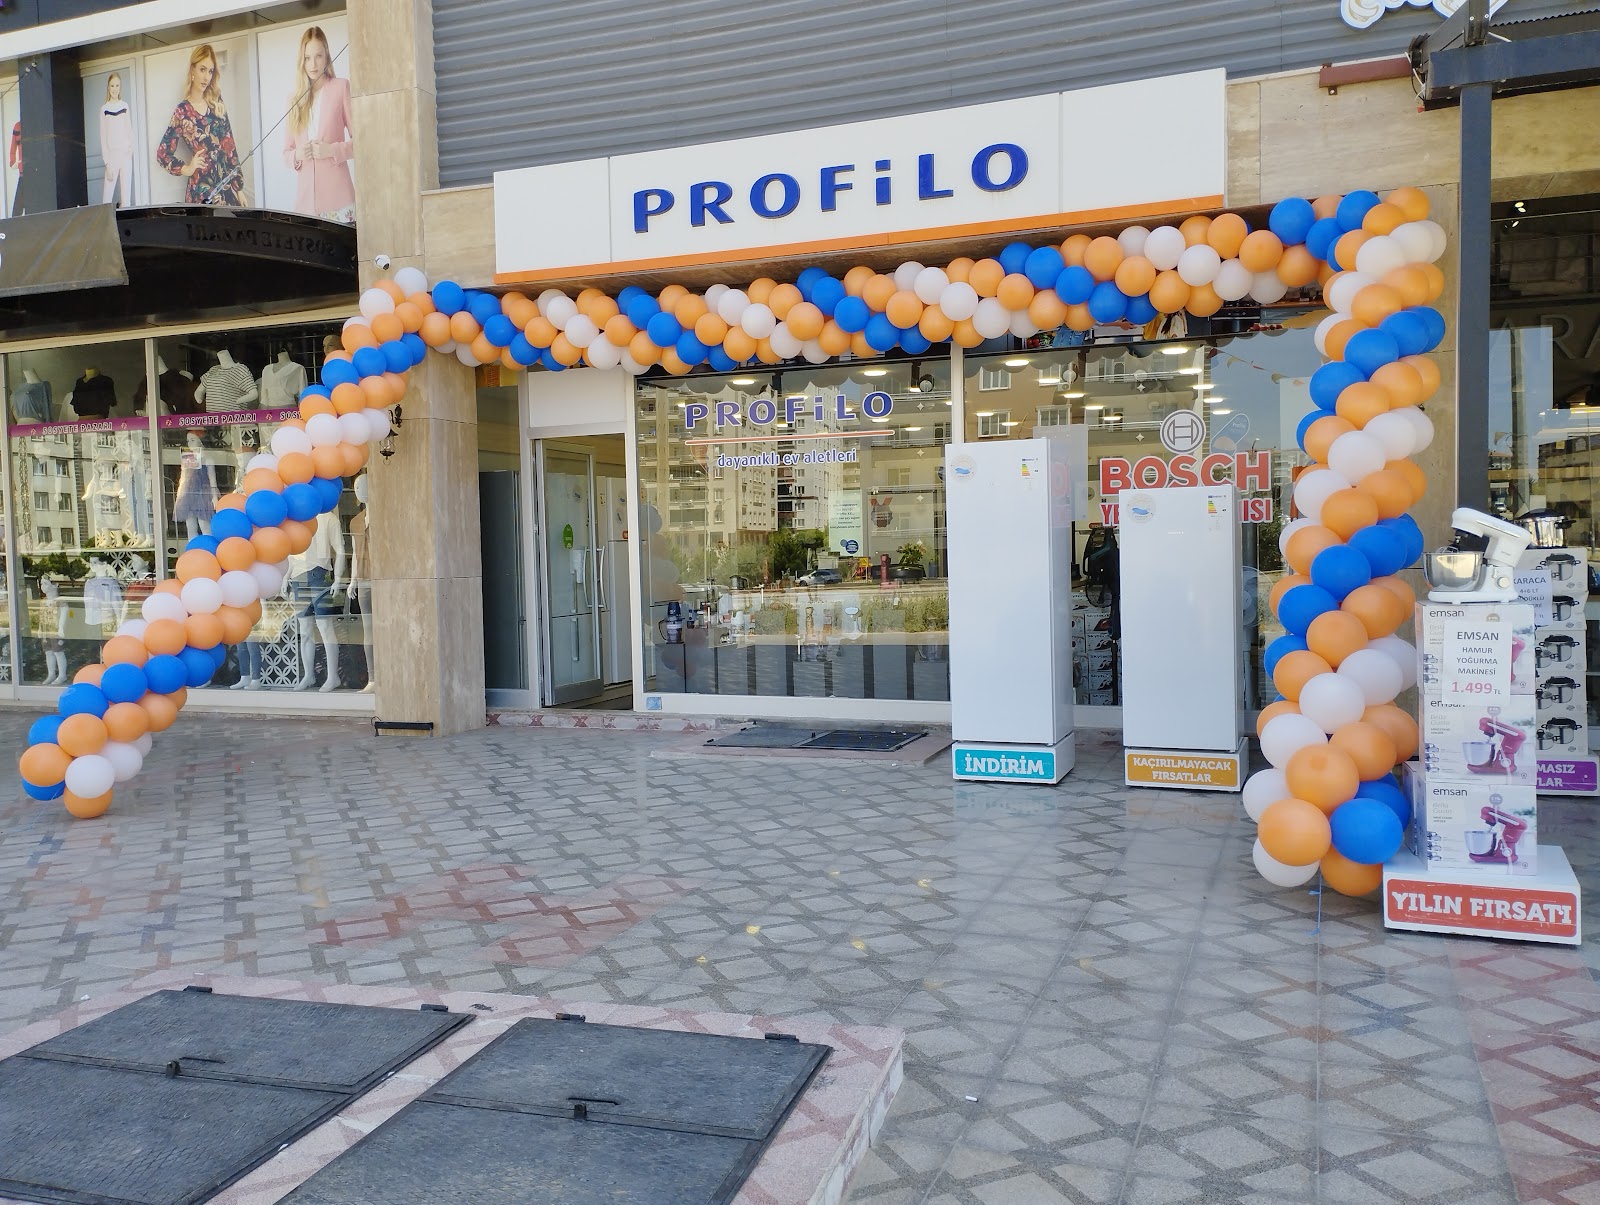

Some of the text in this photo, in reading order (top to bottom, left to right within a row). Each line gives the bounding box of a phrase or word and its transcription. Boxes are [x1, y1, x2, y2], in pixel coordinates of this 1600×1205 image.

[179, 415, 219, 426] SOSYETE
[221, 412, 257, 424] PAZARI
[42, 421, 113, 436] SOSYETE PAZARI
[783, 455, 800, 467] ev
[804, 448, 858, 465] aletleri
[1100, 451, 1272, 496] BOSCH
[1429, 610, 1465, 618] emsan
[1456, 631, 1500, 641] EMSAN
[1462, 646, 1493, 654] HAMUR
[1451, 681, 1493, 694] 1.499
[964, 752, 1045, 776] İNDİRİM
[1152, 770, 1212, 783] FIRSATLAR
[1432, 788, 1468, 796] emsan
[1391, 891, 1573, 925] YILIN FIRSATI
